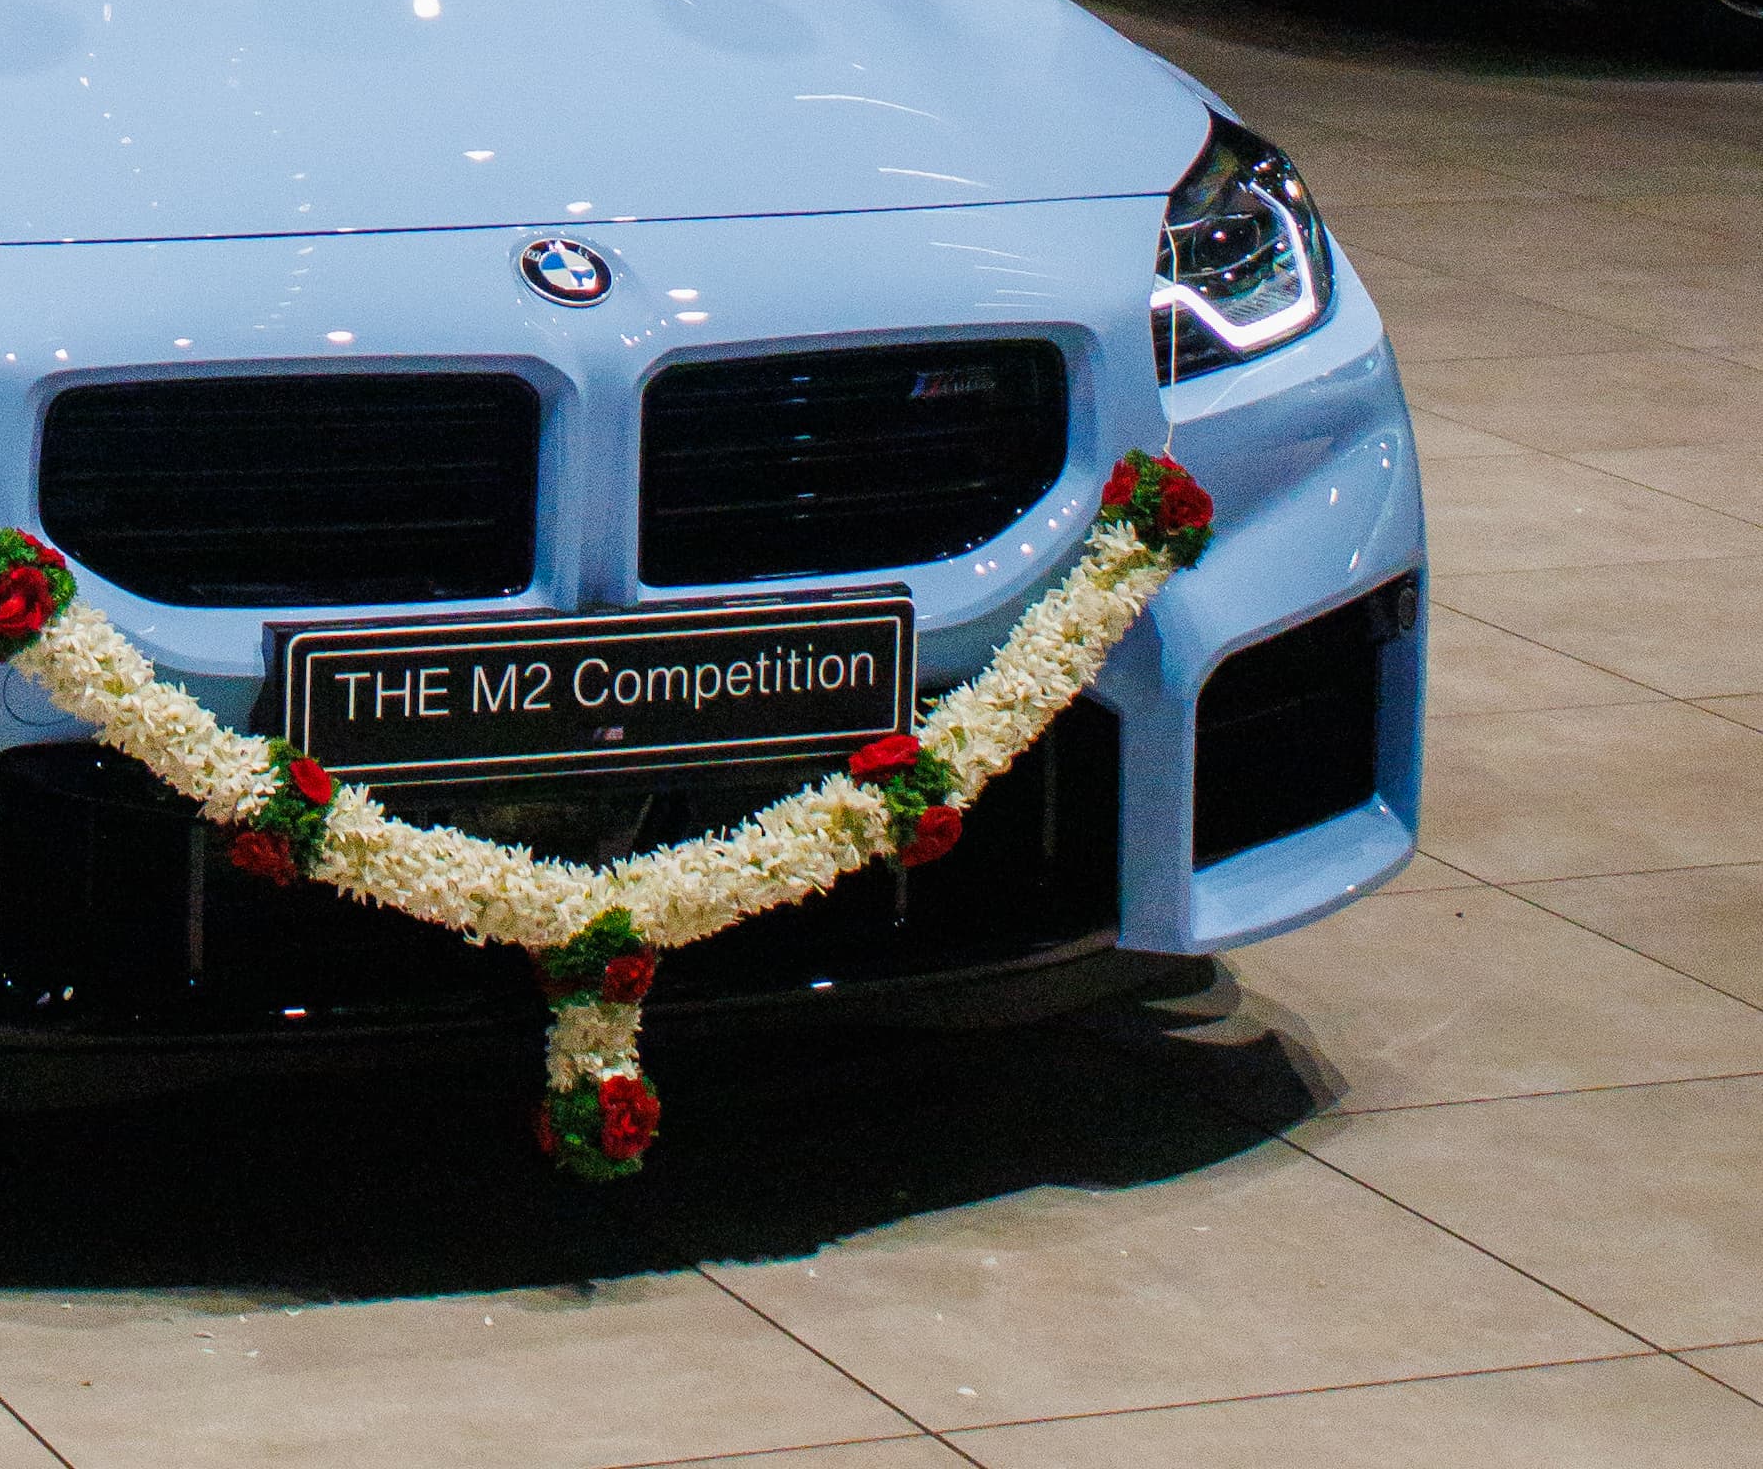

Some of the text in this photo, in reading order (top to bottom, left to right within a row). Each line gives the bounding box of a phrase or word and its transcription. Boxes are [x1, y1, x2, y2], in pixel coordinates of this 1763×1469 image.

[334, 643, 876, 721] THE M2 Competition
